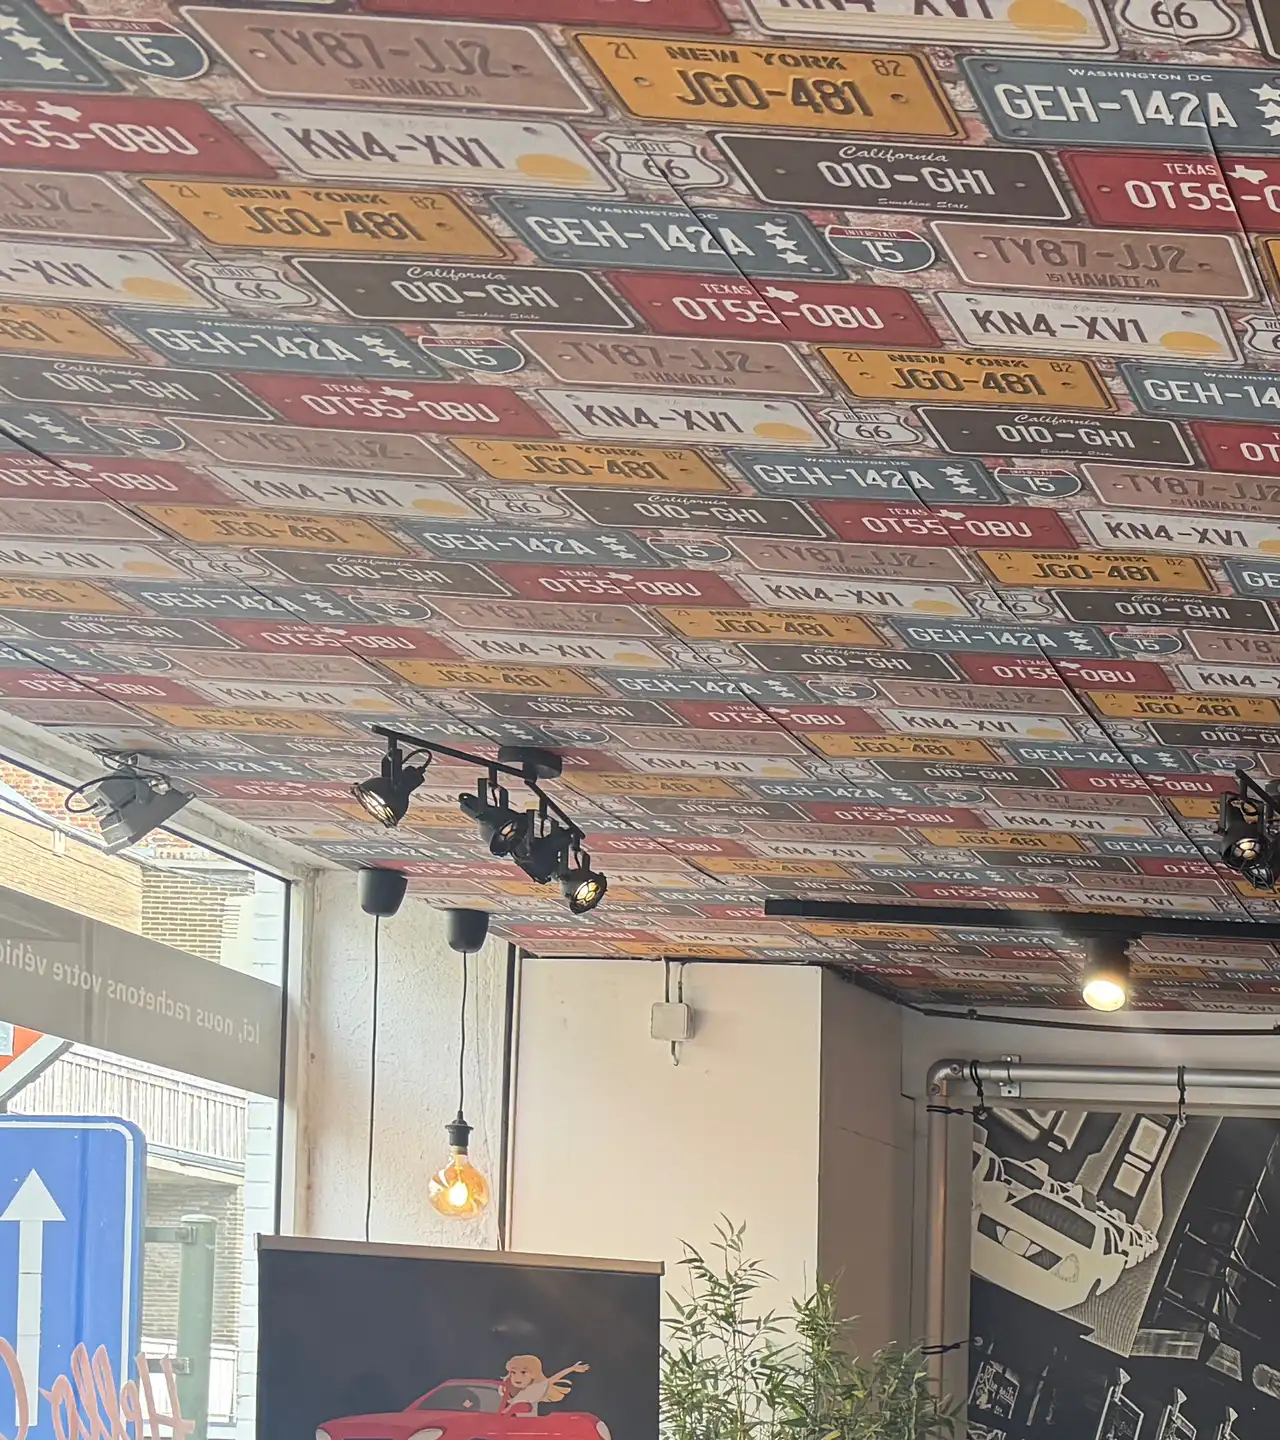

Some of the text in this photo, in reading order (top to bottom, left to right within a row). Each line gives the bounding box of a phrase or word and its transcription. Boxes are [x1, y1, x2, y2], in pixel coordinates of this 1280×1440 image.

[1149, 0, 1199, 30] 66
[114, 35, 175, 67] 15
[664, 46, 739, 62] NEW
[754, 51, 847, 70] YORK
[641, 157, 690, 180] 66
[1163, 162, 1217, 175] TEXAS
[525, 215, 755, 256] GEH-142A
[861, 240, 904, 263] 15
